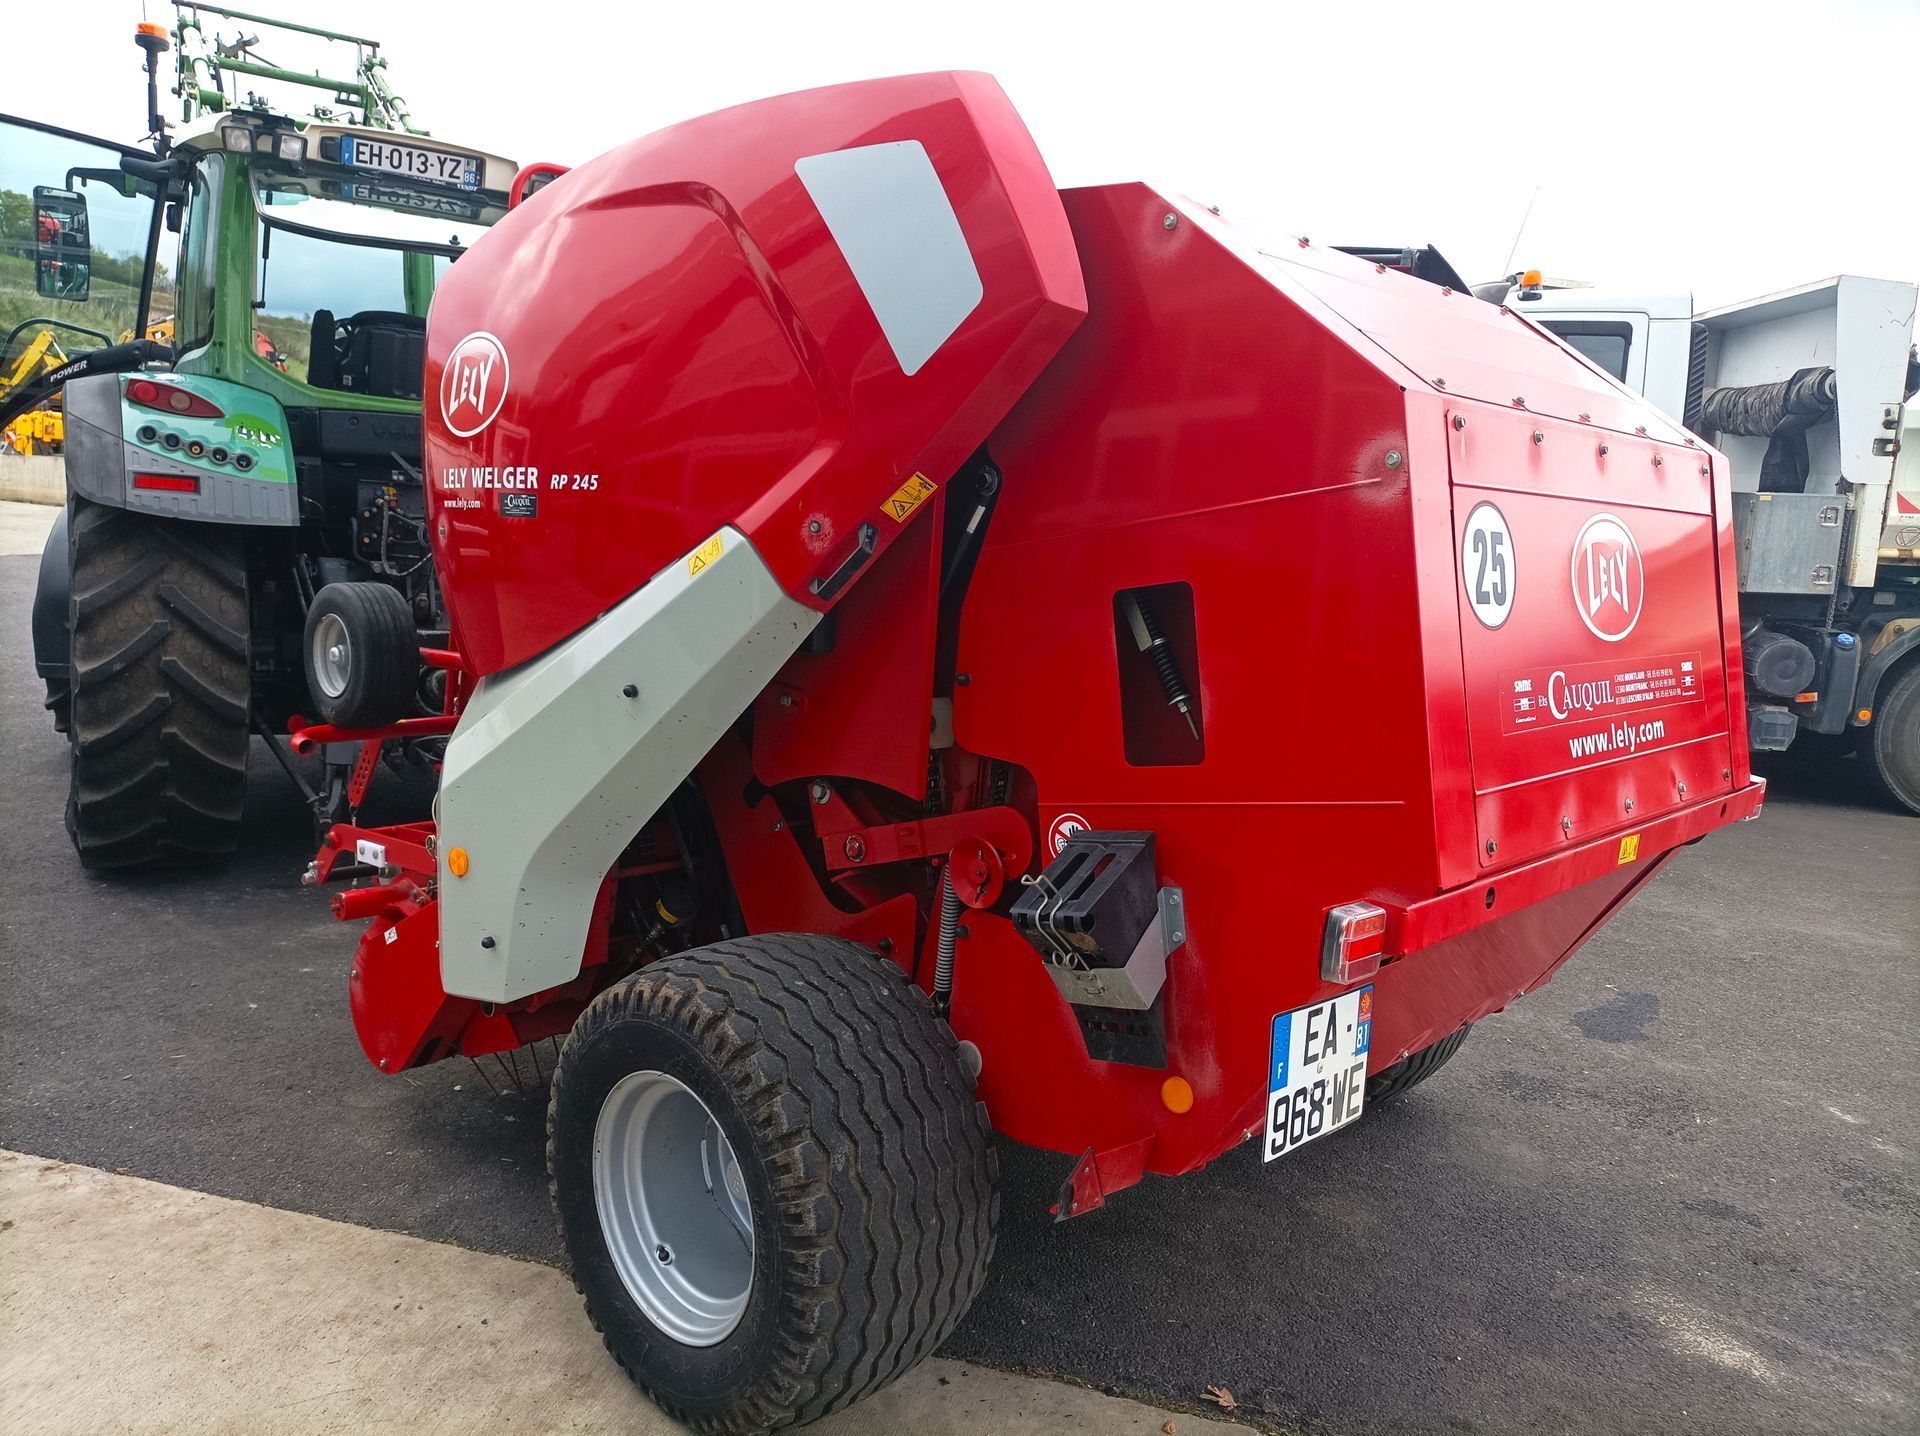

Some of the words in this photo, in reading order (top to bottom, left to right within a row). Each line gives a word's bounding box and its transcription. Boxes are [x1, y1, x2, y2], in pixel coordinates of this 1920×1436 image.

[355, 142, 462, 180] EH-013-YZ
[464, 172, 475, 183] 86
[50, 360, 87, 383] POWER
[448, 352, 495, 417] LELY
[443, 468, 467, 489] LELY
[471, 466, 538, 489] WELGER
[550, 474, 568, 489] RP
[571, 474, 599, 490] 245
[443, 498, 480, 510] www.lely.com
[1473, 529, 1507, 606] 25
[1586, 537, 1629, 618] LELY
[1548, 670, 1614, 720] CAUQUIL
[1569, 719, 1665, 758] www.lely.com
[1356, 1023, 1368, 1048] 81
[1277, 1062, 1283, 1080] F
[1271, 1061, 1364, 1155] 968-WE
